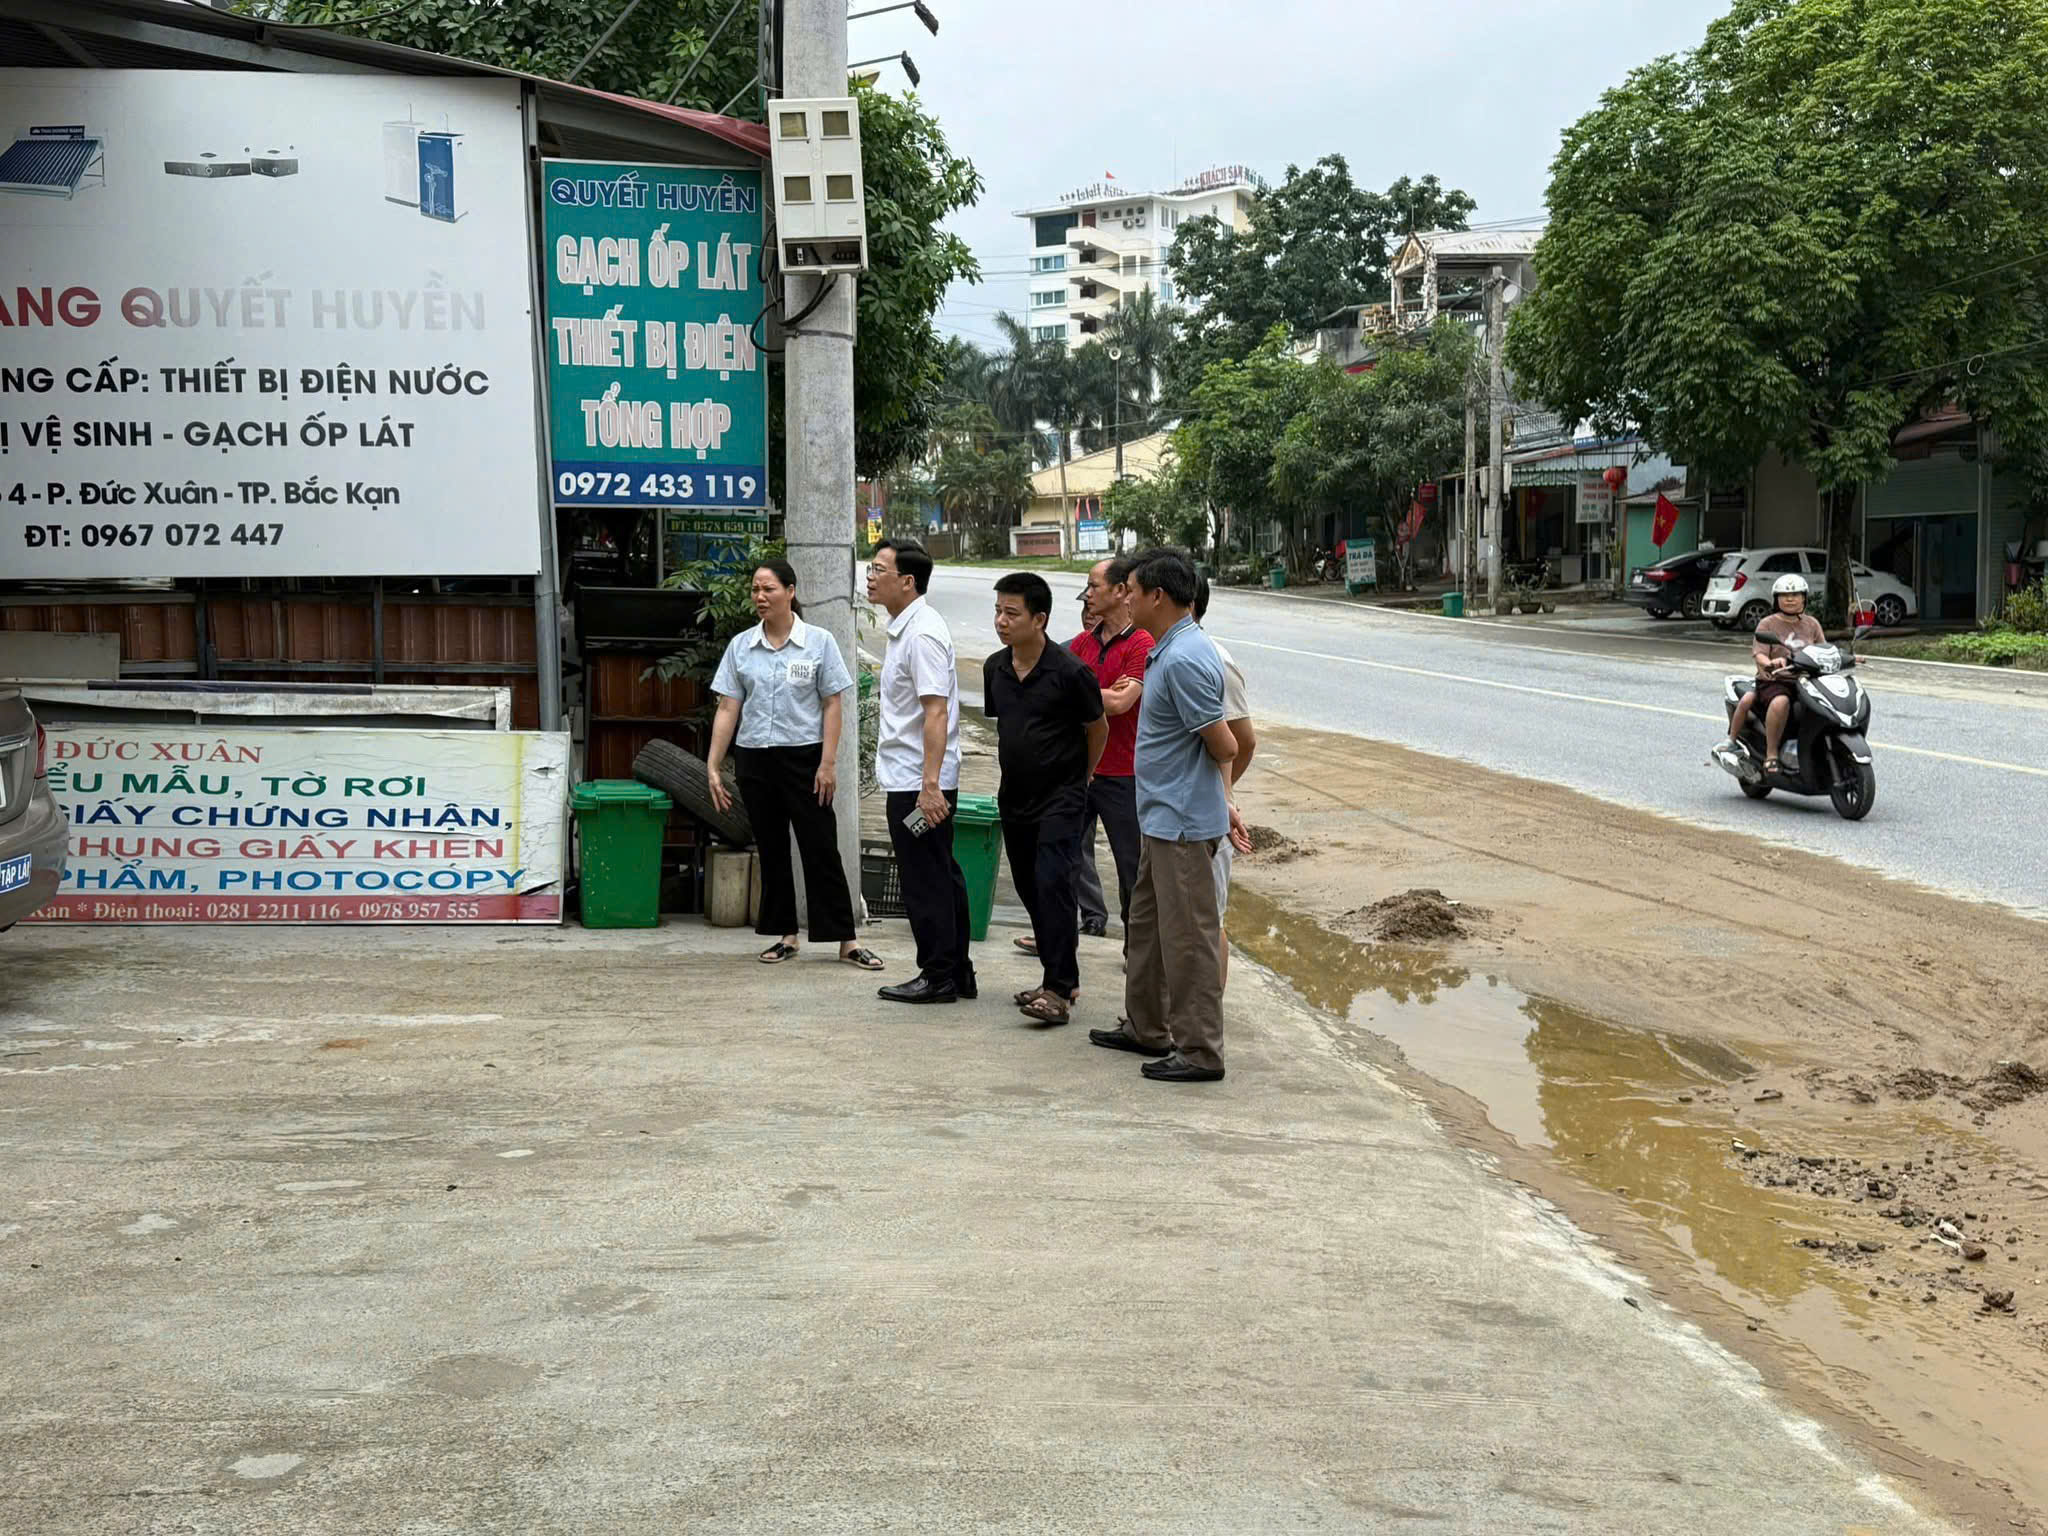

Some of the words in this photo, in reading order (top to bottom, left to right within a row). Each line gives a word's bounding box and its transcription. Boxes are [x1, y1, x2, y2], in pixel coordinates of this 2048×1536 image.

[551, 170, 649, 208] QUYẾT
[656, 174, 756, 213] HUYỀN
[556, 234, 640, 296] GẠCH
[648, 222, 690, 289] ỐP
[697, 232, 752, 291] LÁT
[120, 270, 292, 329] QUYẾT
[311, 270, 486, 331] HUYỀN
[552, 304, 637, 368] THIẾT
[645, 321, 678, 379] BỊ
[684, 313, 756, 381] ĐIỆN
[66, 355, 150, 393] CẤP:
[160, 356, 247, 393] THIẾT
[258, 368, 288, 401] BỊ
[300, 362, 377, 401] ĐIỆN
[389, 363, 489, 395] NƯỚC
[20, 414, 62, 454] VỆ
[73, 421, 152, 447] SINH
[183, 421, 289, 454] GẠCH
[300, 410, 348, 447] ỐP
[359, 415, 415, 448] LÁT
[580, 382, 662, 449] TỔNG
[671, 398, 731, 460] HỢP
[8, 483, 26, 505] 4
[47, 483, 72, 505] P.
[79, 480, 136, 505] Đức
[143, 480, 218, 504] Xuân
[238, 482, 277, 504] TP.
[284, 475, 338, 504] Bắc
[345, 482, 400, 511] Kạn
[558, 471, 631, 497] 0972
[640, 473, 694, 499] 433
[705, 474, 757, 500] 119
[24, 524, 71, 547] ĐT:
[81, 524, 154, 547] 0967
[165, 523, 221, 546] 072
[230, 523, 284, 546] 447
[53, 737, 139, 761] ĐỨC
[151, 739, 264, 763] XUÂN
[122, 765, 243, 799] MẪU,
[261, 771, 327, 797] TỜ
[344, 775, 426, 797] RƠI
[171, 802, 348, 827] CHỨNG
[367, 803, 512, 831] NHẬN,
[239, 832, 358, 859] GIẤY
[374, 838, 504, 859] KHEN
[1, 864, 17, 888] TẬP
[18, 858, 30, 880] LÁI
[94, 902, 143, 921] Điện
[145, 902, 200, 921] thoại:
[207, 903, 249, 919] 0281
[257, 903, 300, 919] 2211
[308, 903, 341, 919] 116
[359, 902, 402, 919] 0978
[408, 902, 441, 919] 957
[447, 902, 480, 919] 555
